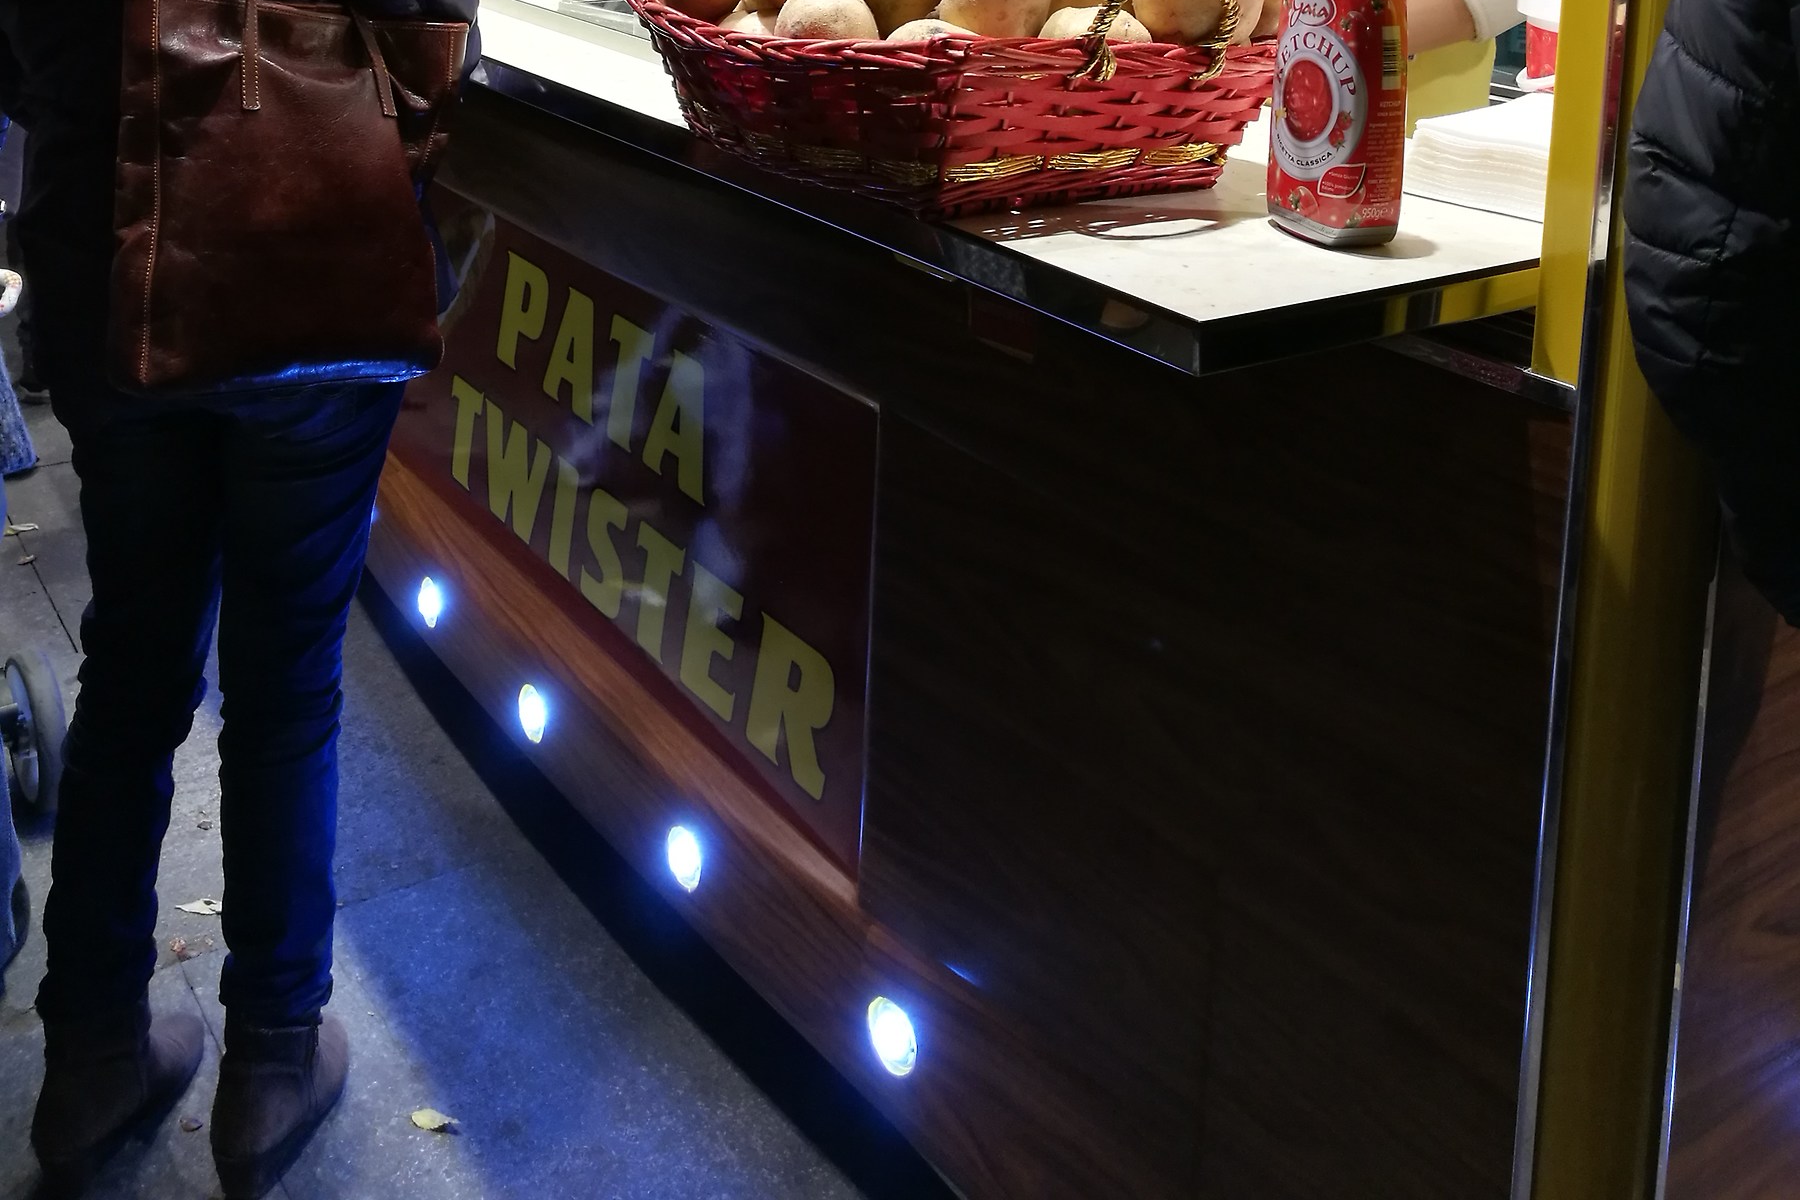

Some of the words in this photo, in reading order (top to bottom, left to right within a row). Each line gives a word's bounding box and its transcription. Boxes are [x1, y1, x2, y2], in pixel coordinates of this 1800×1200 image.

[1276, 31, 1357, 97] KETCHUP
[1296, 151, 1332, 167] CLASSICA
[496, 250, 706, 507] PATA
[451, 374, 835, 801] TWISTER
